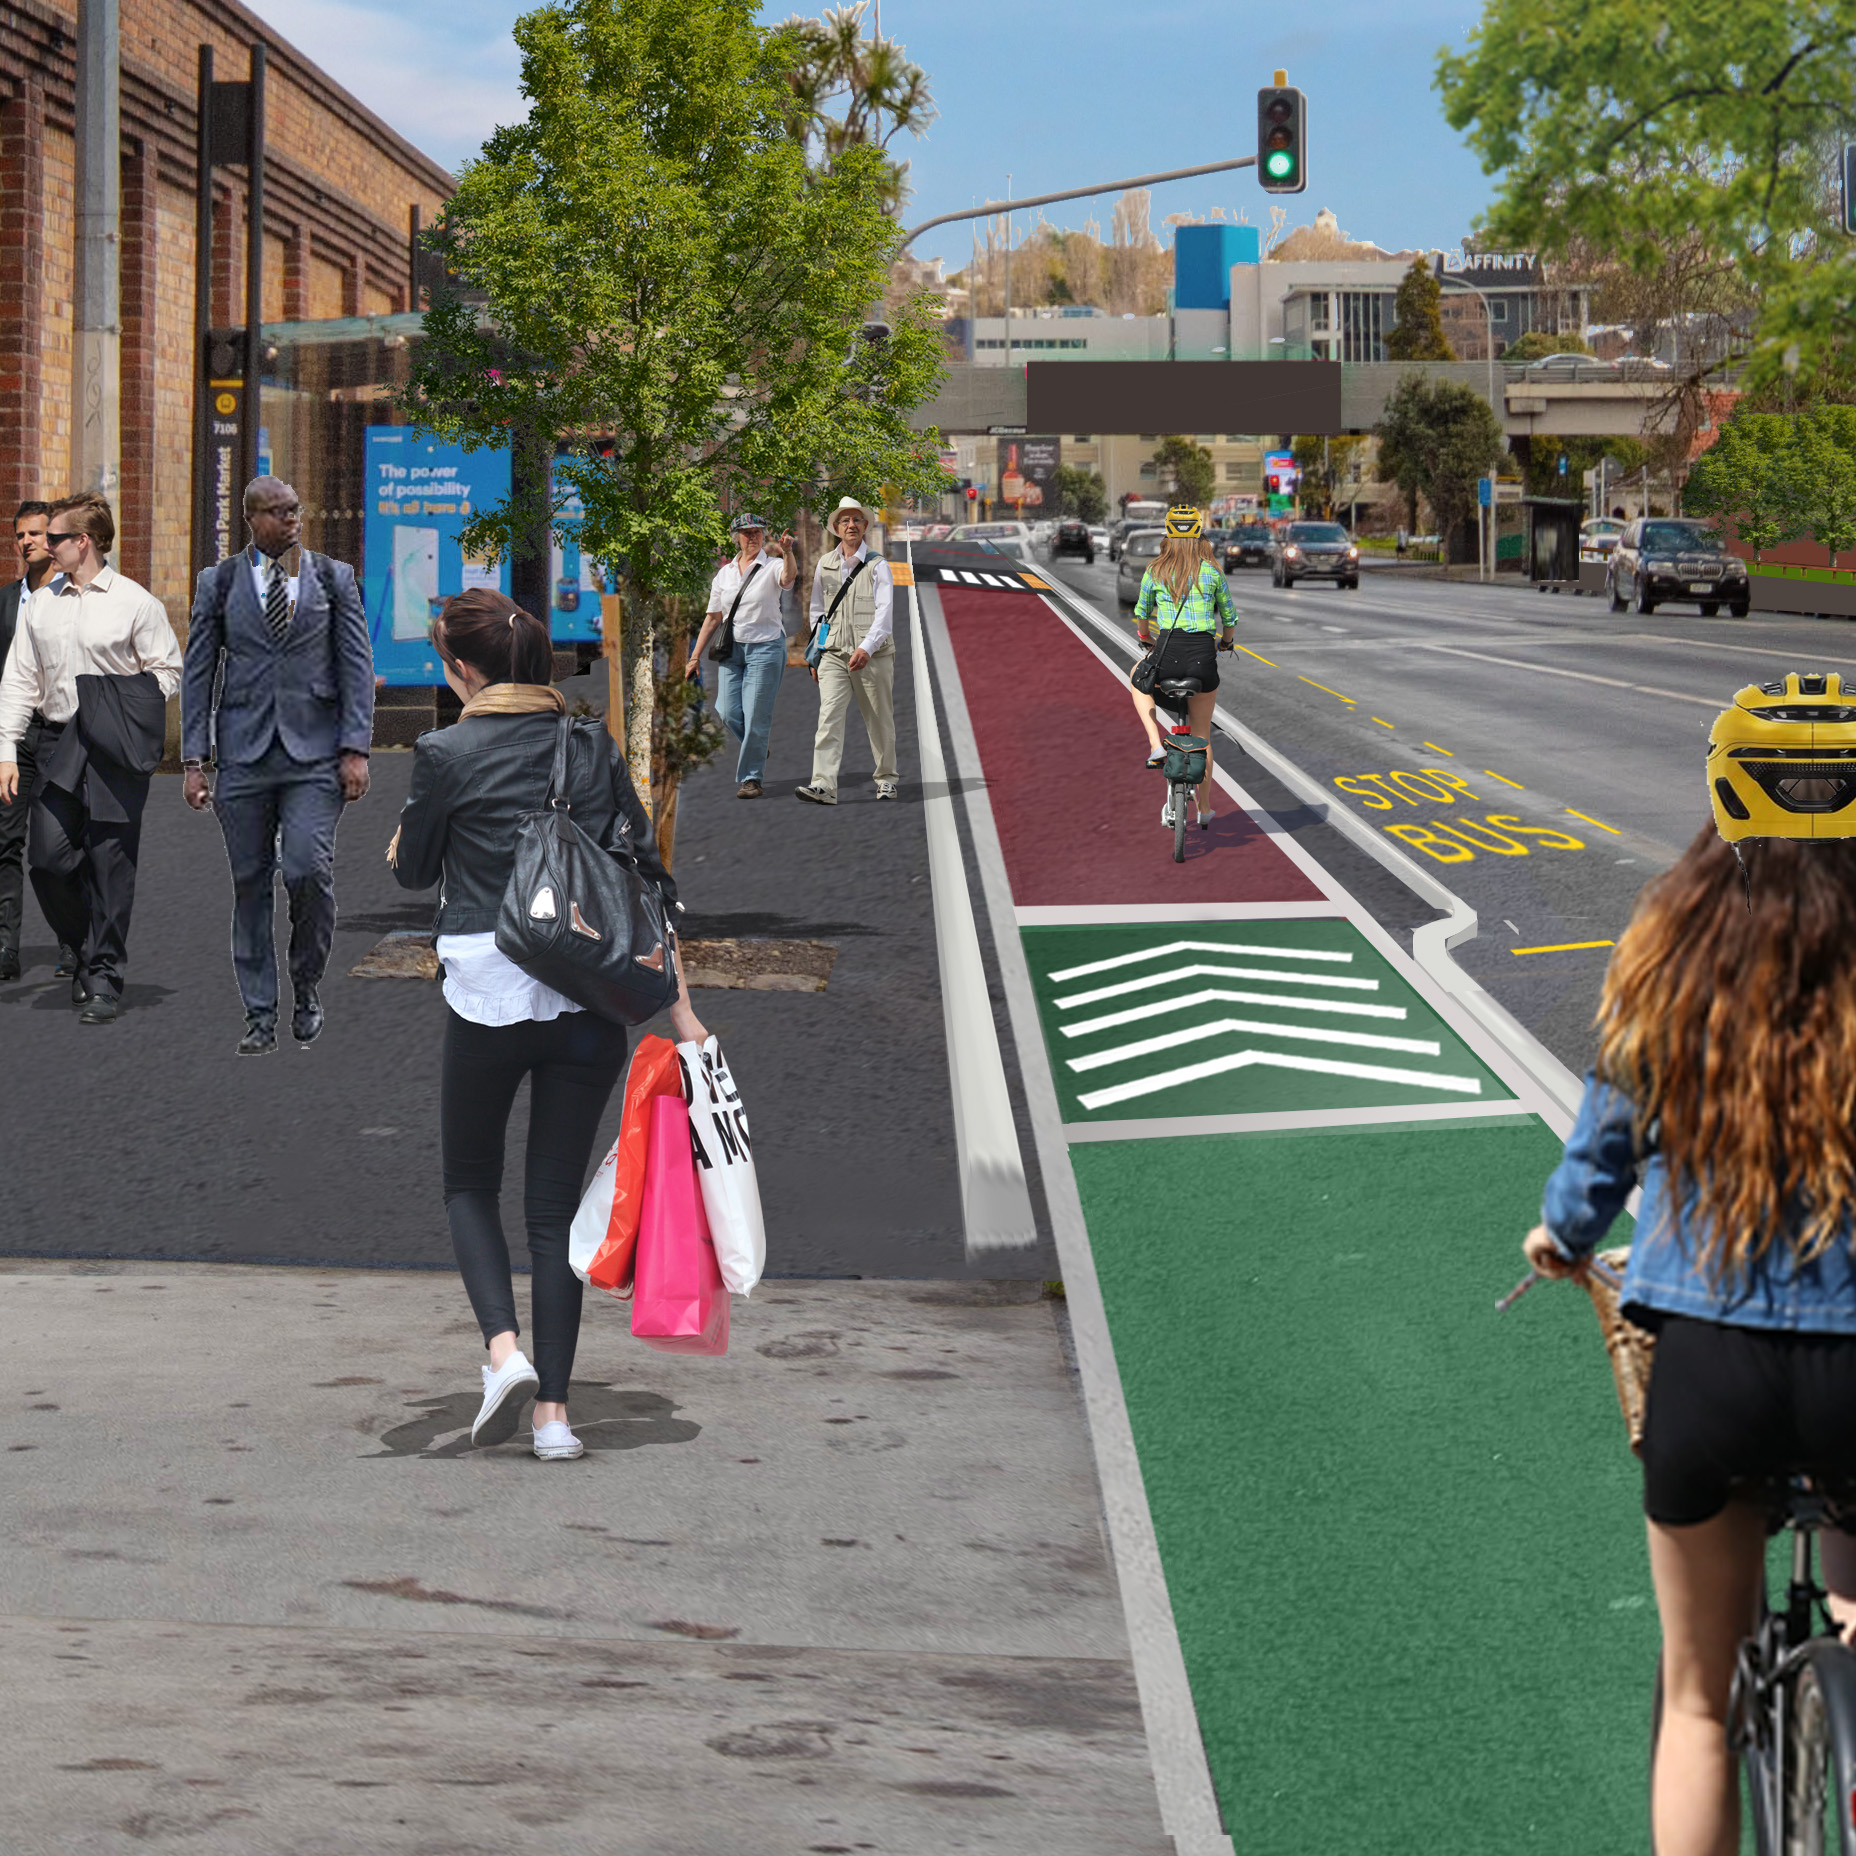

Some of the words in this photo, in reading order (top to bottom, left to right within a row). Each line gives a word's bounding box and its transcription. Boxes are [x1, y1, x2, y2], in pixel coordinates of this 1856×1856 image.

[1464, 253, 1536, 271] AFFINITY
[217, 446, 232, 496] Market
[378, 464, 407, 479] The
[410, 466, 458, 480] power
[378, 481, 395, 497] of
[396, 482, 471, 499] possibility
[216, 498, 231, 530] Park
[1334, 768, 1480, 810] STOP
[1383, 814, 1586, 863] BUS
